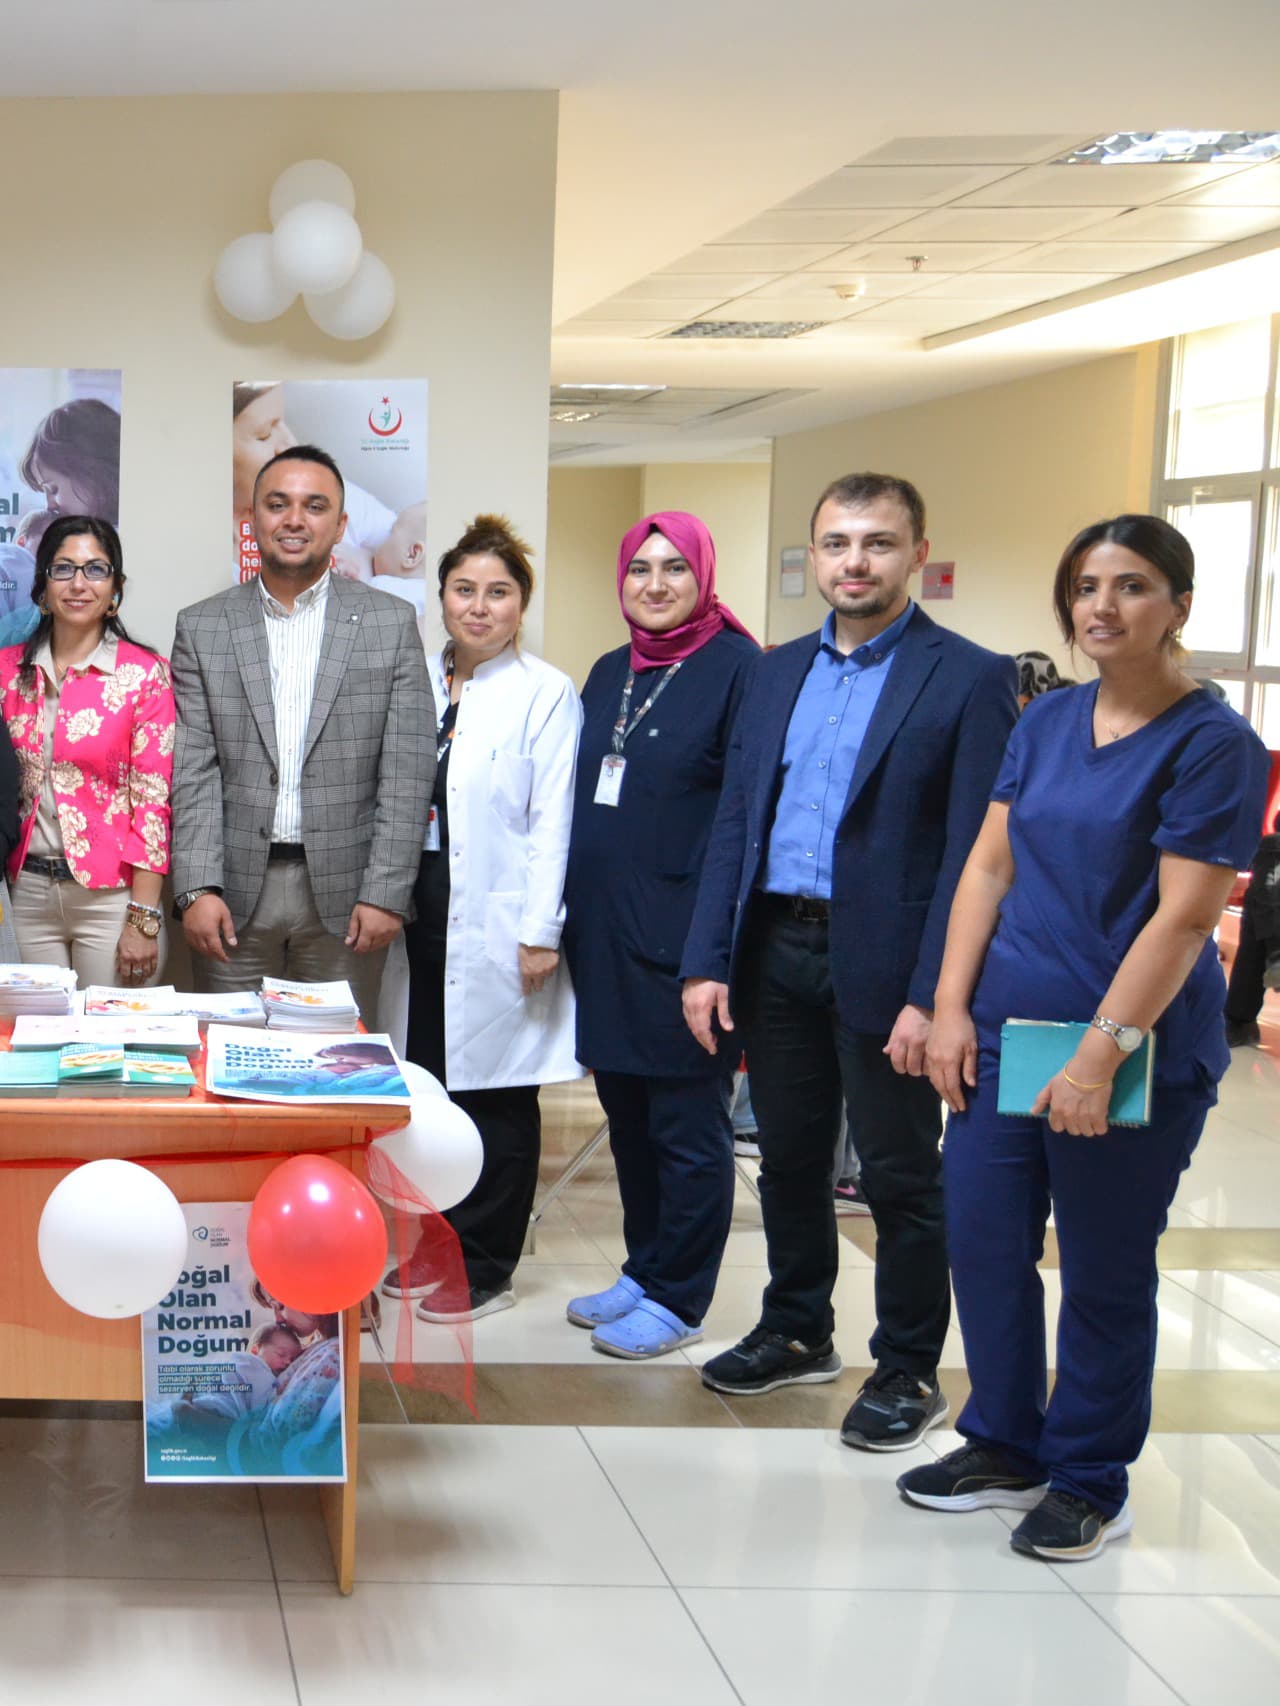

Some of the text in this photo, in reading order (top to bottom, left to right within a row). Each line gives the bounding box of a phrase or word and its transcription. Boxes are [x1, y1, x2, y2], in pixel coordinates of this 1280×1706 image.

[178, 1265, 230, 1289] oğal
[158, 1310, 251, 1331] Normal
[158, 1335, 249, 1358] Doğum
